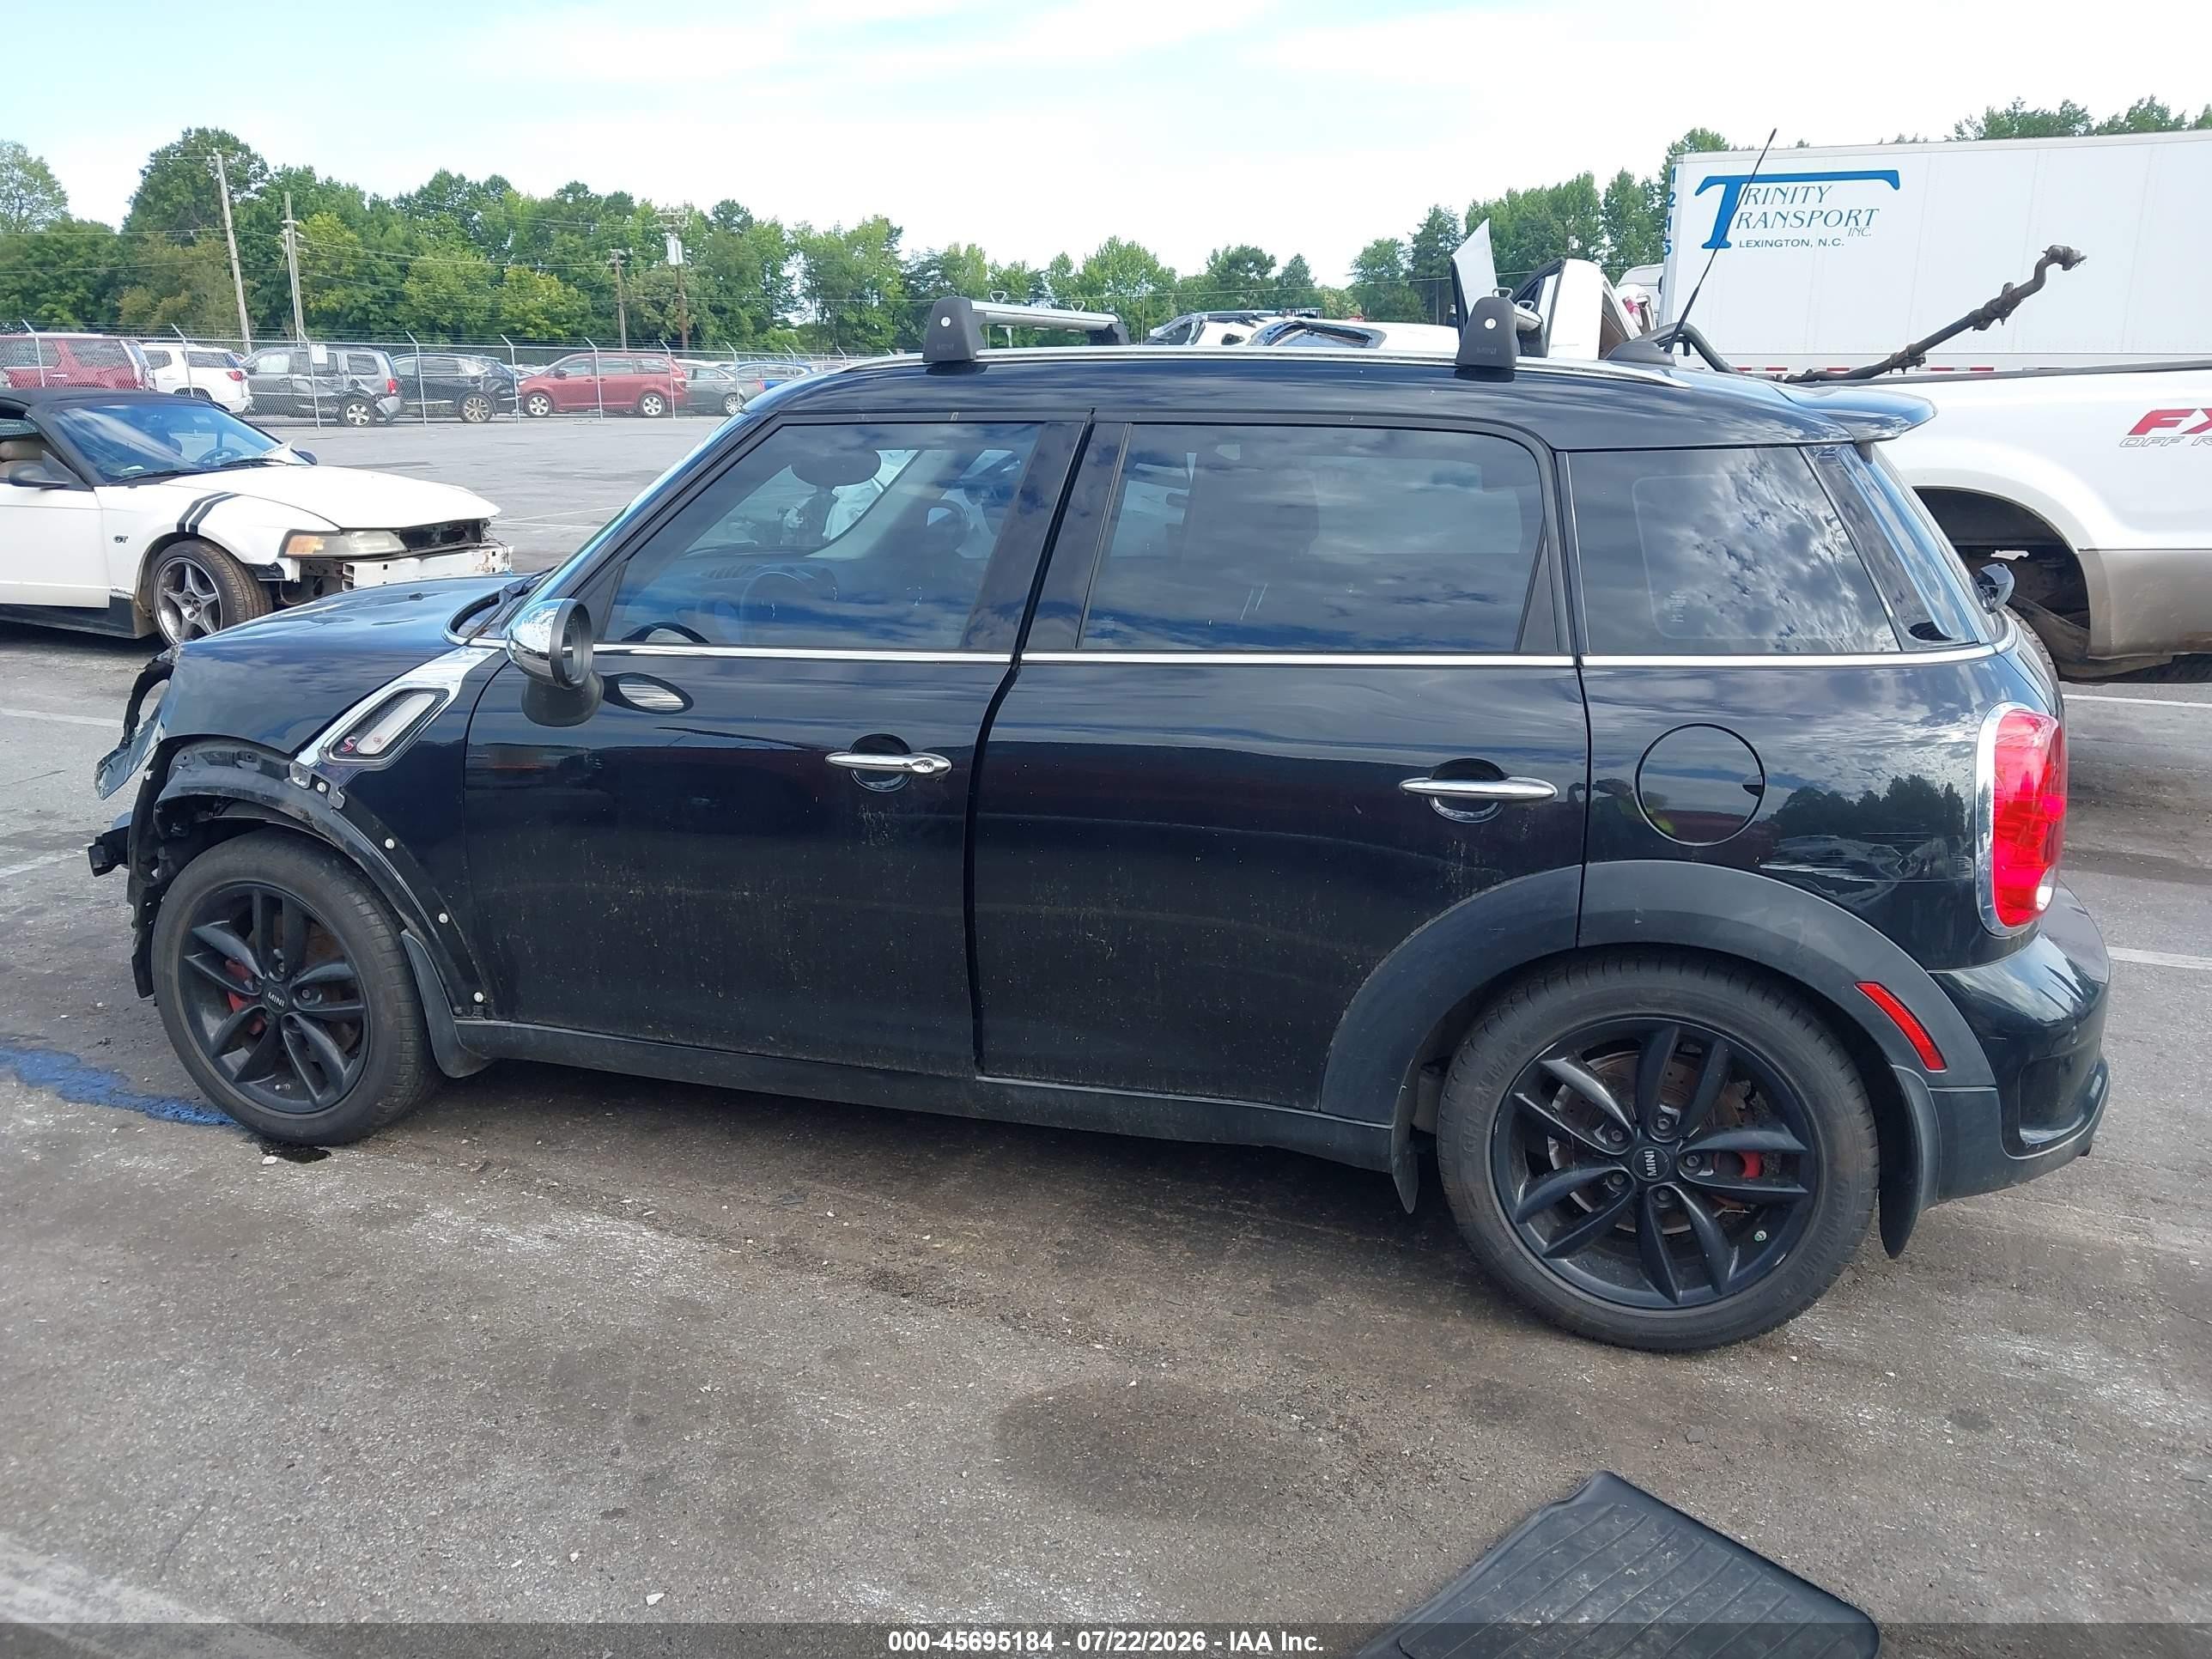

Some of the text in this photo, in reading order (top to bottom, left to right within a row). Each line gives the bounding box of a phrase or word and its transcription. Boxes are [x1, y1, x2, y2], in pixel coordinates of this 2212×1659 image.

[1848, 227, 1872, 237] INC.
[1739, 238, 1845, 248] LEXINGTON, N.C.
[2119, 436, 2185, 447] OFF
[113, 535, 129, 544] GT
[340, 736, 356, 752] S
[267, 992, 285, 1007] MINI
[1644, 1151, 1657, 1176] MINI
